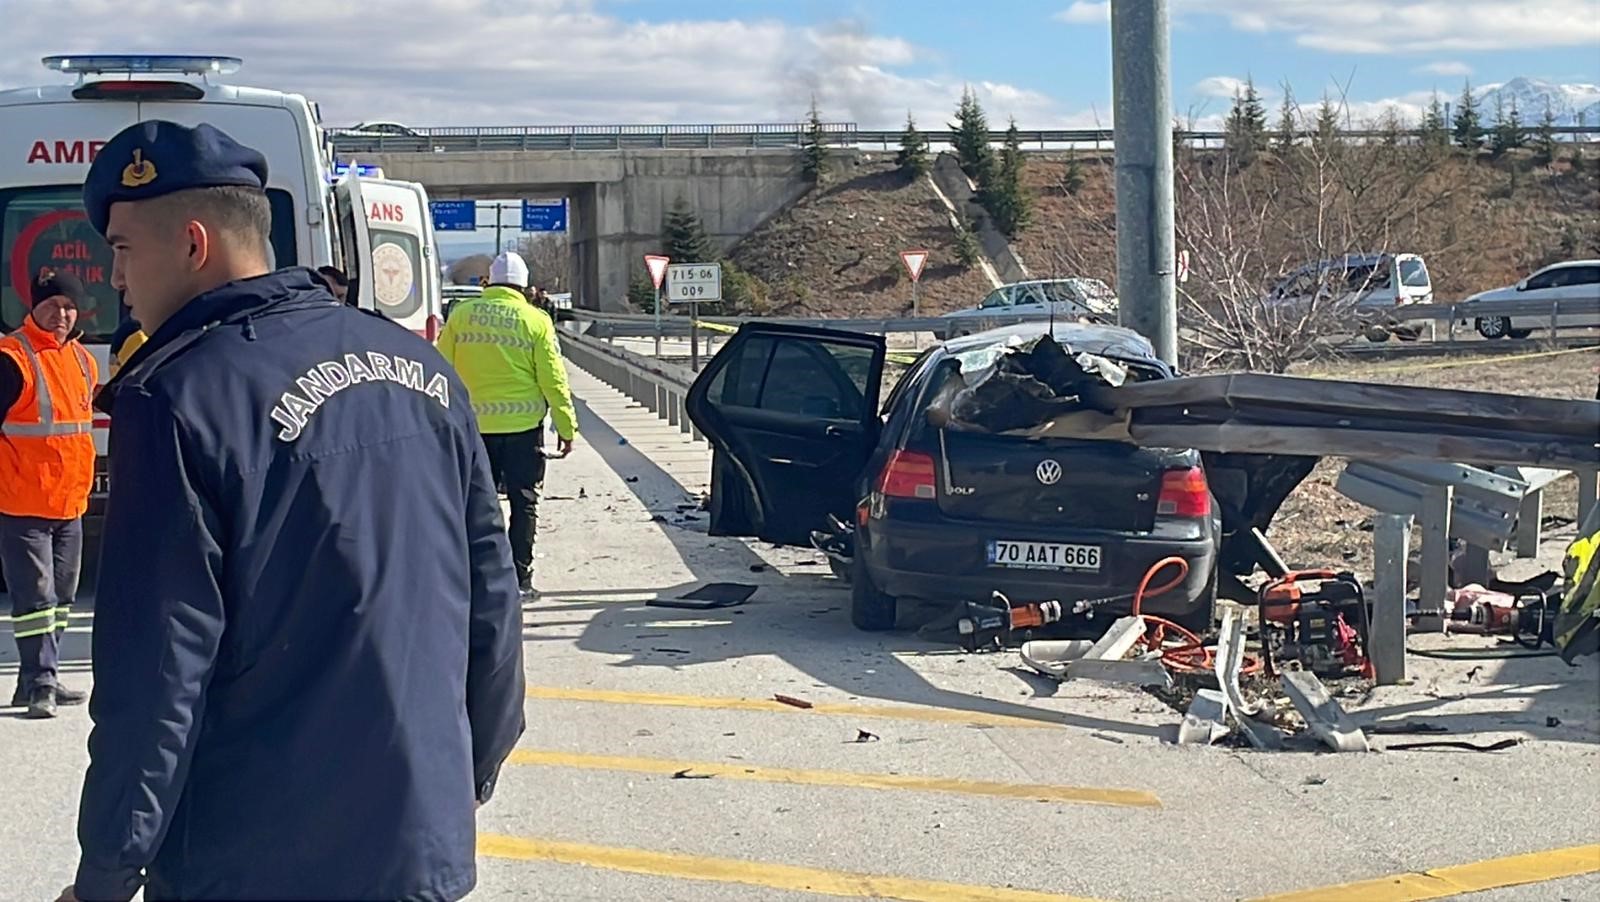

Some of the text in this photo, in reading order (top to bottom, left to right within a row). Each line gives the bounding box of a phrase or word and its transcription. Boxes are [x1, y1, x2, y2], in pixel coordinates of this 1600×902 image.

[370, 203, 404, 222] ANS
[681, 286, 704, 296] 009
[270, 351, 450, 442] JANDARMA
[998, 543, 1098, 566] 70 AAT 666
